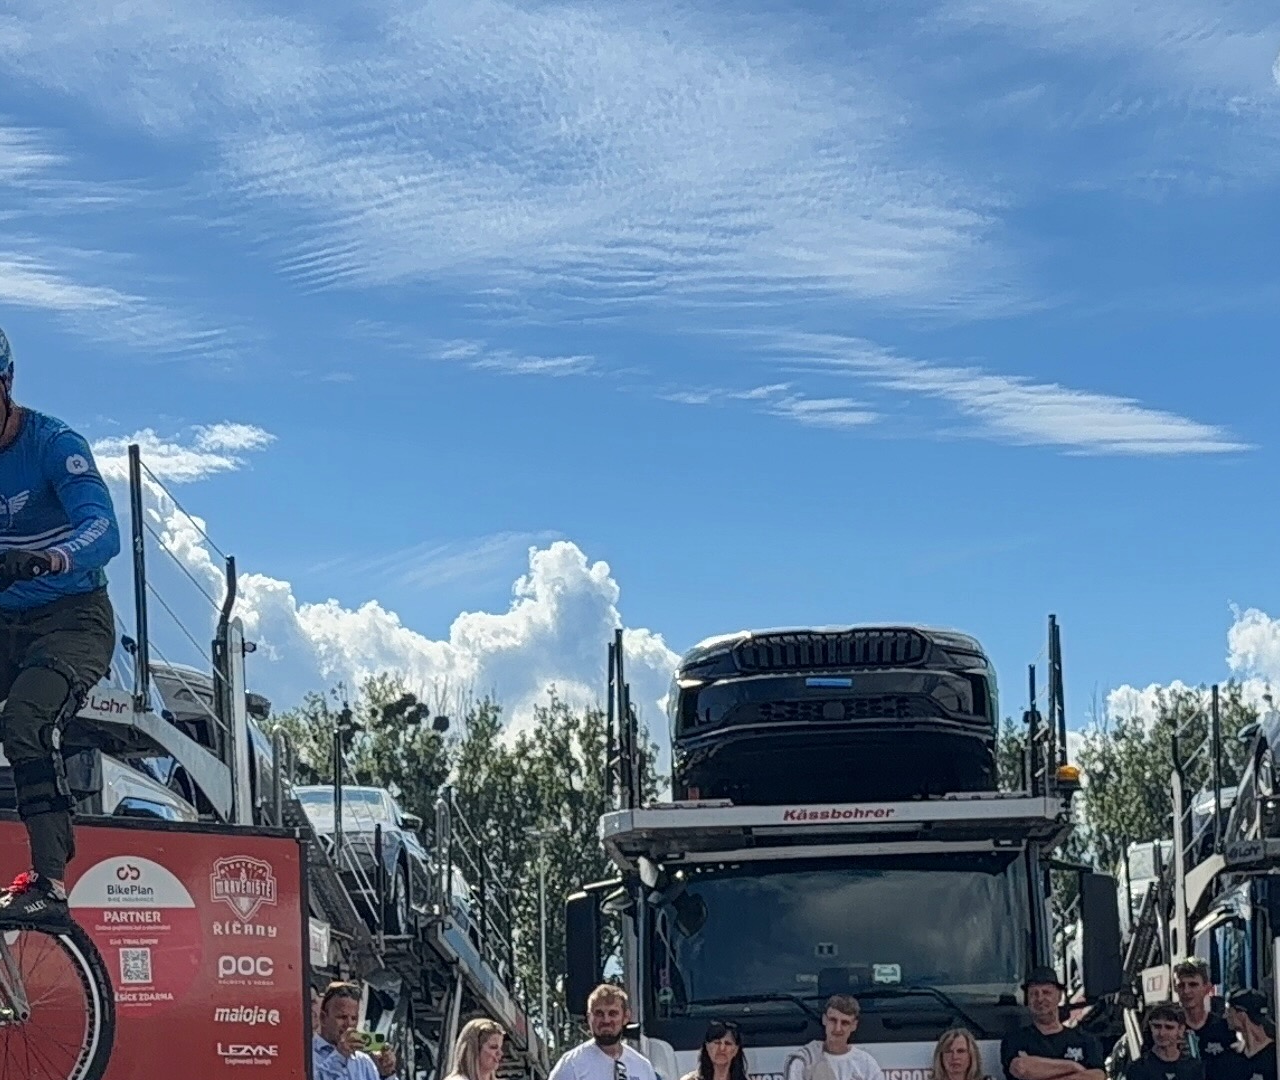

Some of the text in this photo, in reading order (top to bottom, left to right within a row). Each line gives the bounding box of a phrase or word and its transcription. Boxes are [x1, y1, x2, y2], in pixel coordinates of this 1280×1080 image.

[91, 695, 128, 713] Lohr
[783, 806, 895, 821] Kässbohrer
[107, 884, 154, 895] BikePlan
[104, 911, 161, 923] PARTNER
[214, 1005, 266, 1025] maloja
[217, 1042, 278, 1056] LEZYNE
